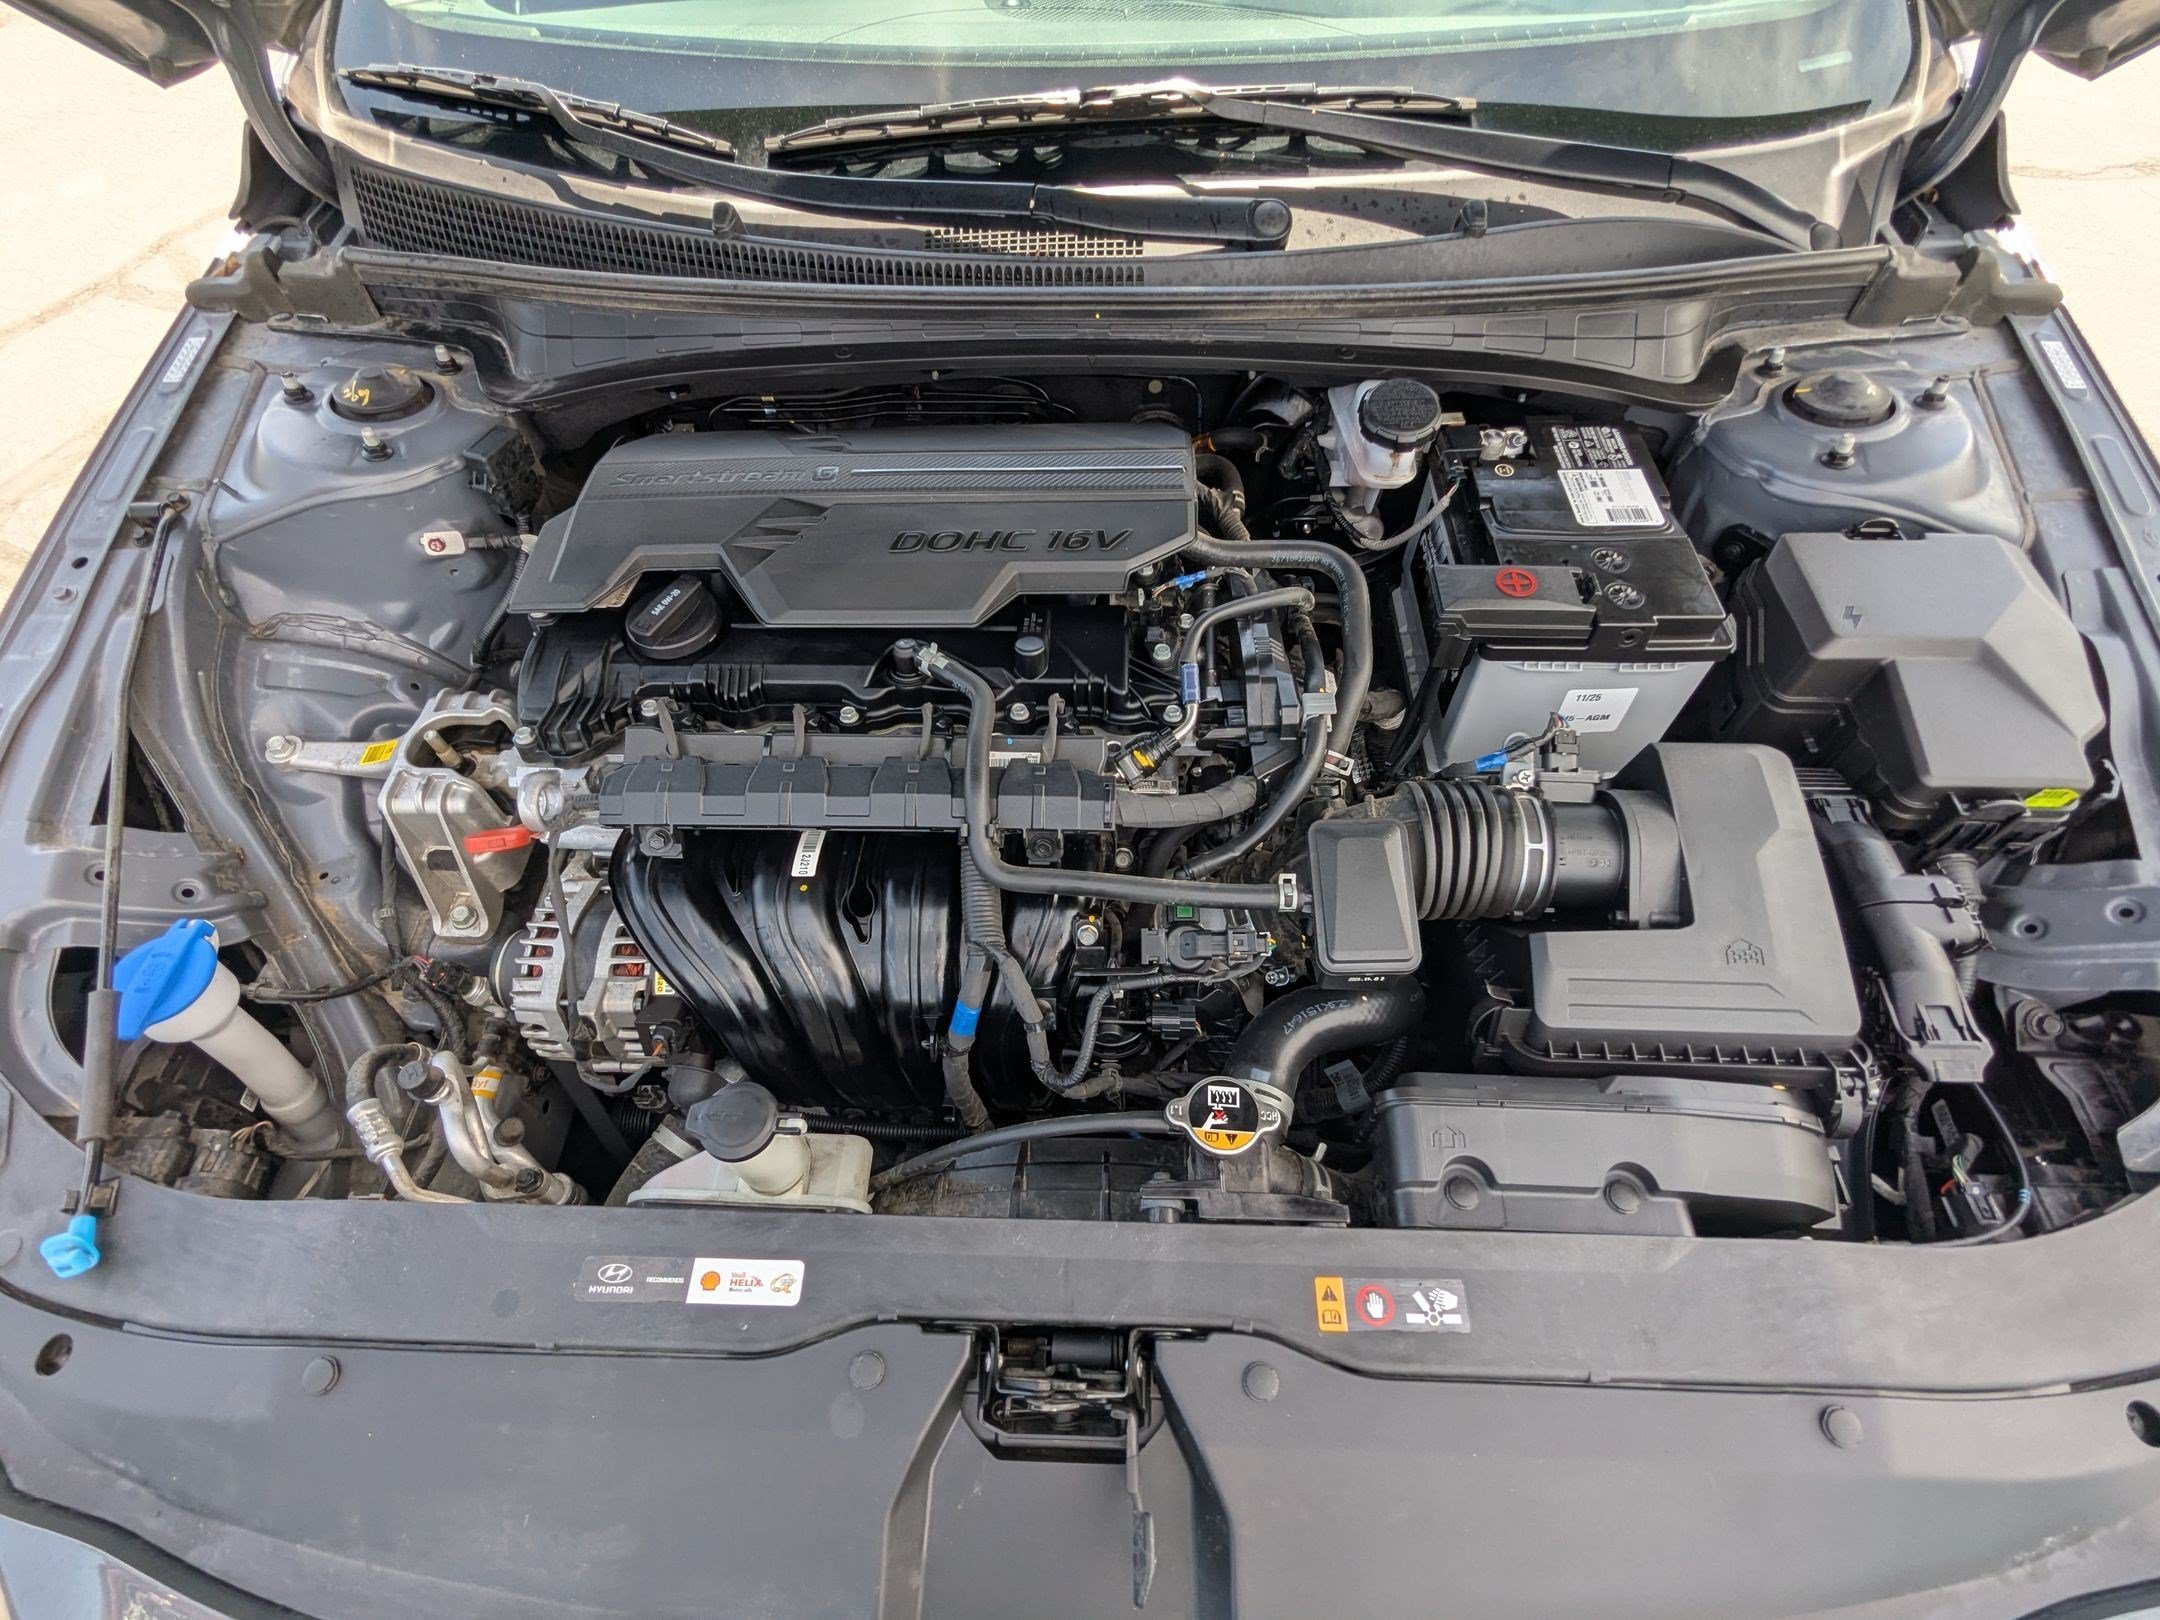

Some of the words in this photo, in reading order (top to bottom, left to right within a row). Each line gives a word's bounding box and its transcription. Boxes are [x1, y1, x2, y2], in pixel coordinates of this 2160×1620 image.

[608, 470, 804, 487] Smartstream
[889, 528, 1037, 553] DOHC
[1047, 528, 1134, 552] 16V
[651, 603, 665, 616] SAE
[1576, 693, 1602, 702] 11/25
[798, 854, 812, 875] 2J210
[1170, 1104, 1183, 1116] 1.1
[1260, 1111, 1278, 1122] HCC
[729, 1278, 764, 1288] HELIX
[588, 1285, 634, 1294] HYUNDAI
